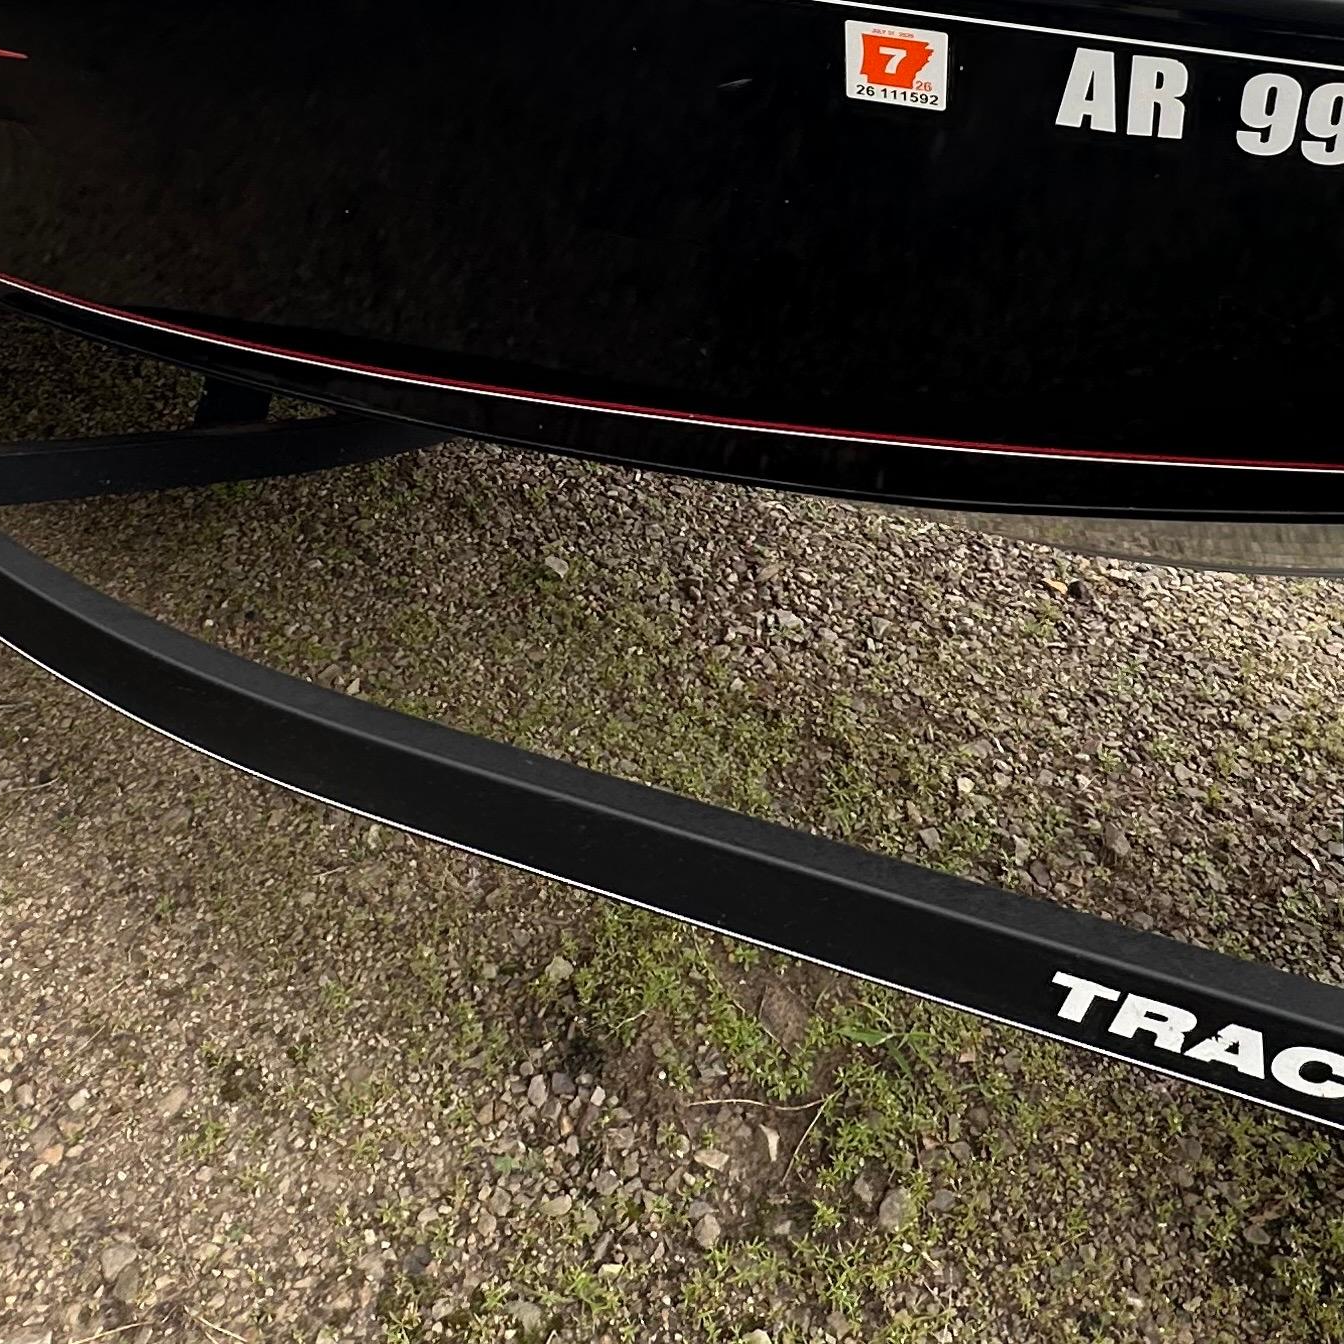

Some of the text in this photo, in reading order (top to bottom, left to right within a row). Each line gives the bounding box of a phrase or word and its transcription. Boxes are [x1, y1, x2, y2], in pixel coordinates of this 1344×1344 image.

[879, 46, 907, 74] 7
[856, 84, 939, 106] 26 111592
[916, 81, 932, 92] 26
[1056, 47, 1189, 140] AR
